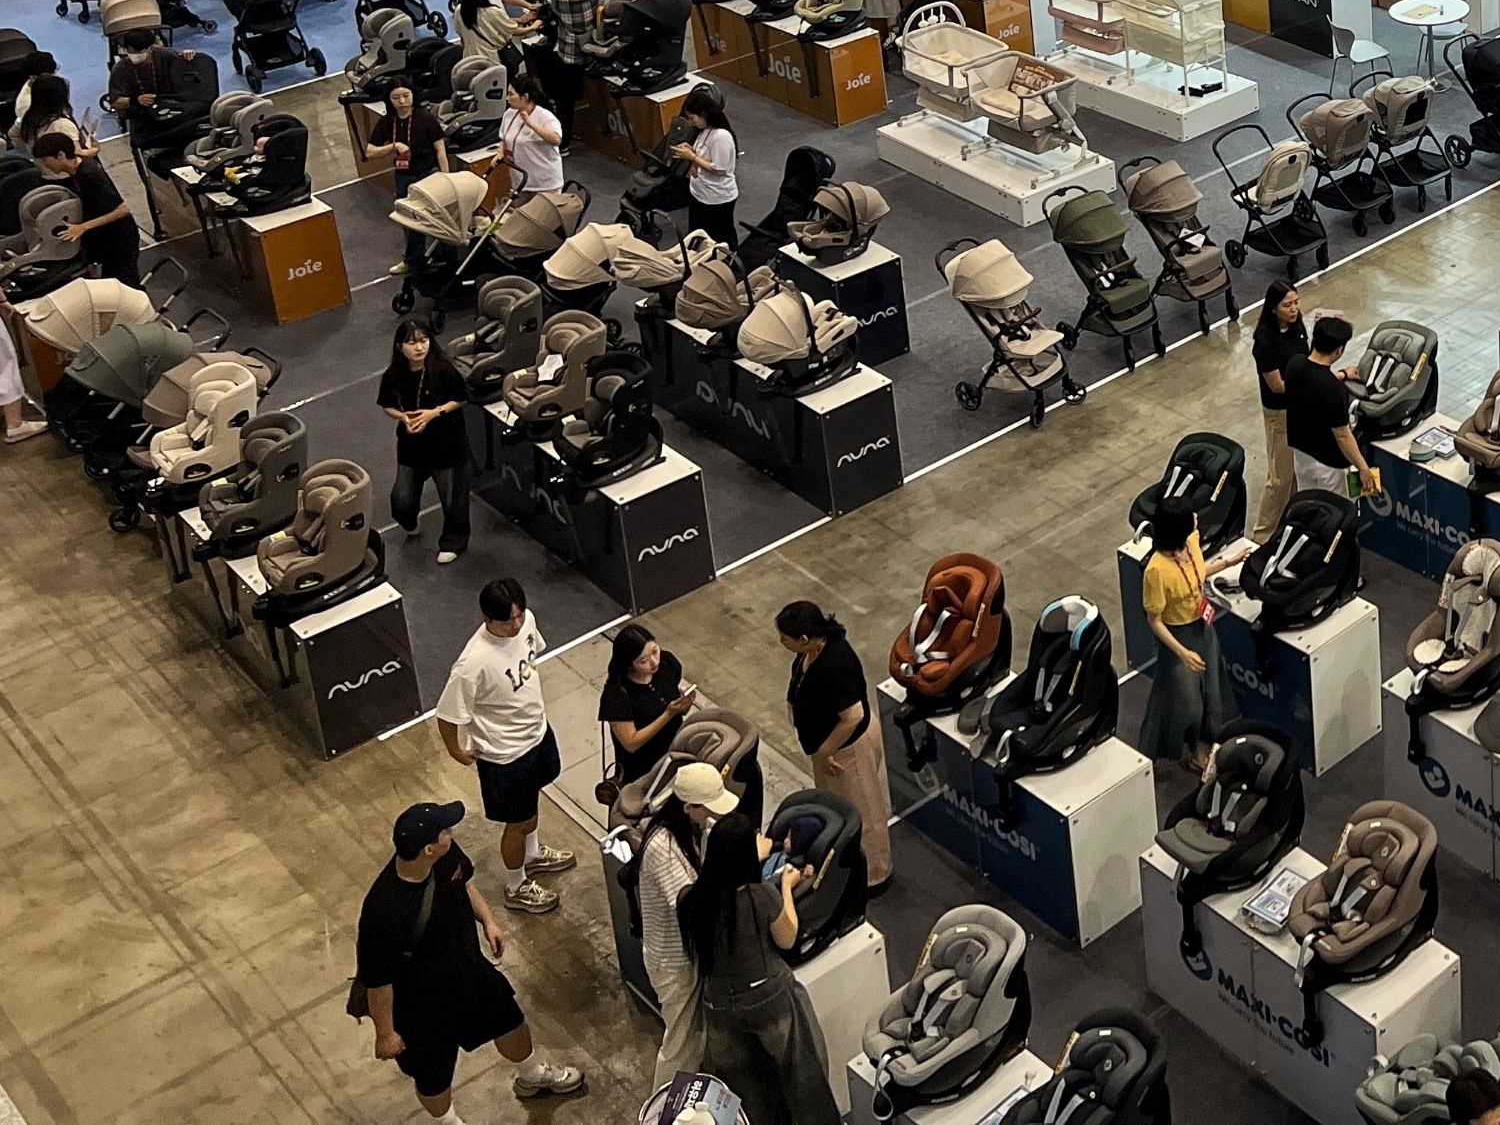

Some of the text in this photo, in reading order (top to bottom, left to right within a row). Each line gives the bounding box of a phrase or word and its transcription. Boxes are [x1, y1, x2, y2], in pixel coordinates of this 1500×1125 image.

[998, 23, 1020, 40] Joie
[768, 53, 802, 84] Joie
[846, 73, 871, 91] Joie
[288, 259, 323, 280] Joie
[837, 436, 891, 468] nuna
[638, 527, 699, 563] nuna
[328, 660, 402, 700] nuna
